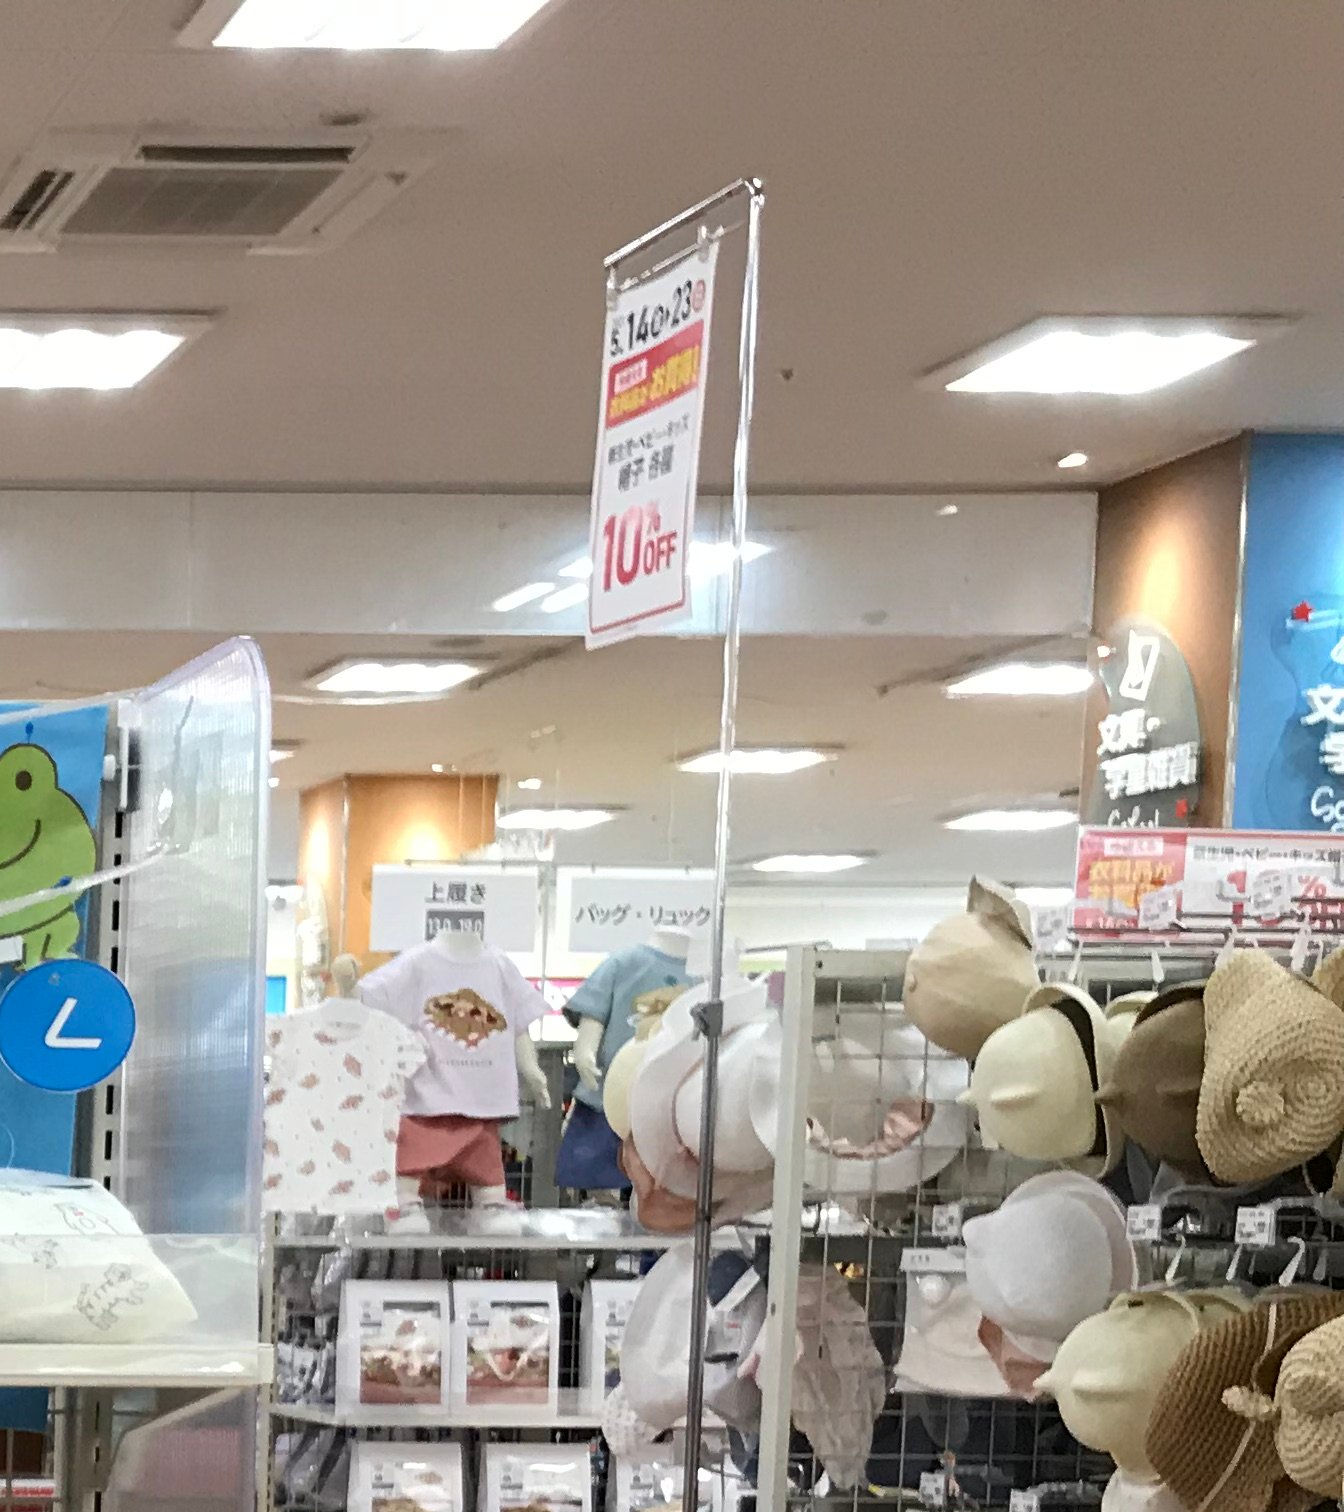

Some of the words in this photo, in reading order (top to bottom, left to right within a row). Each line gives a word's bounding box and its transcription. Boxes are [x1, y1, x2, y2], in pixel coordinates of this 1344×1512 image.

[644, 530, 678, 576] OFF
[424, 880, 486, 905] 上履き
[575, 904, 711, 926] バッグ・リュック
